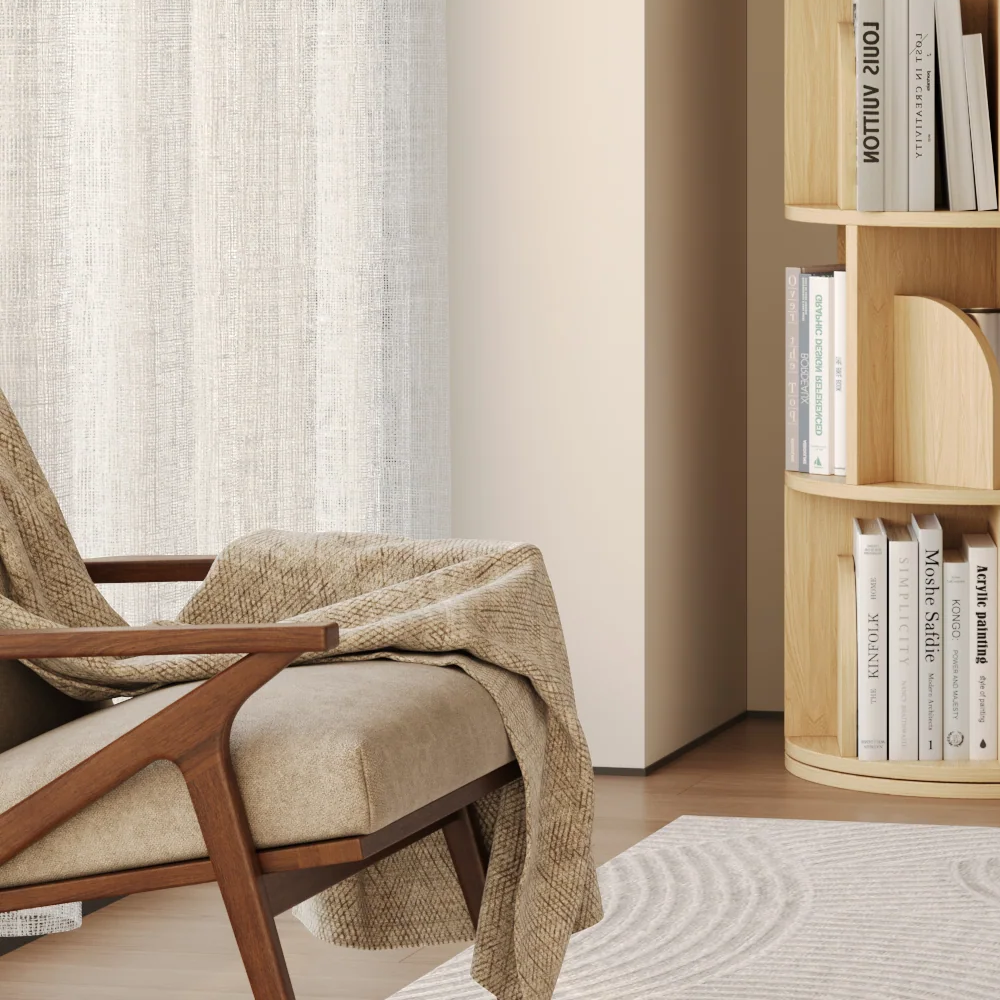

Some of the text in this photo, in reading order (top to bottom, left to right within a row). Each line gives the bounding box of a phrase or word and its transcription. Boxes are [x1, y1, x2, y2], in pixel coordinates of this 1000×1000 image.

[898, 557, 909, 666] SIMPLICITY
[925, 549, 939, 662] Moshe Safdie
[951, 600, 960, 641] KONGO:
[976, 565, 988, 664] Acrylic painting
[868, 613, 879, 679] KINFOLK
[978, 699, 986, 723] painting
[979, 675, 987, 690] style
